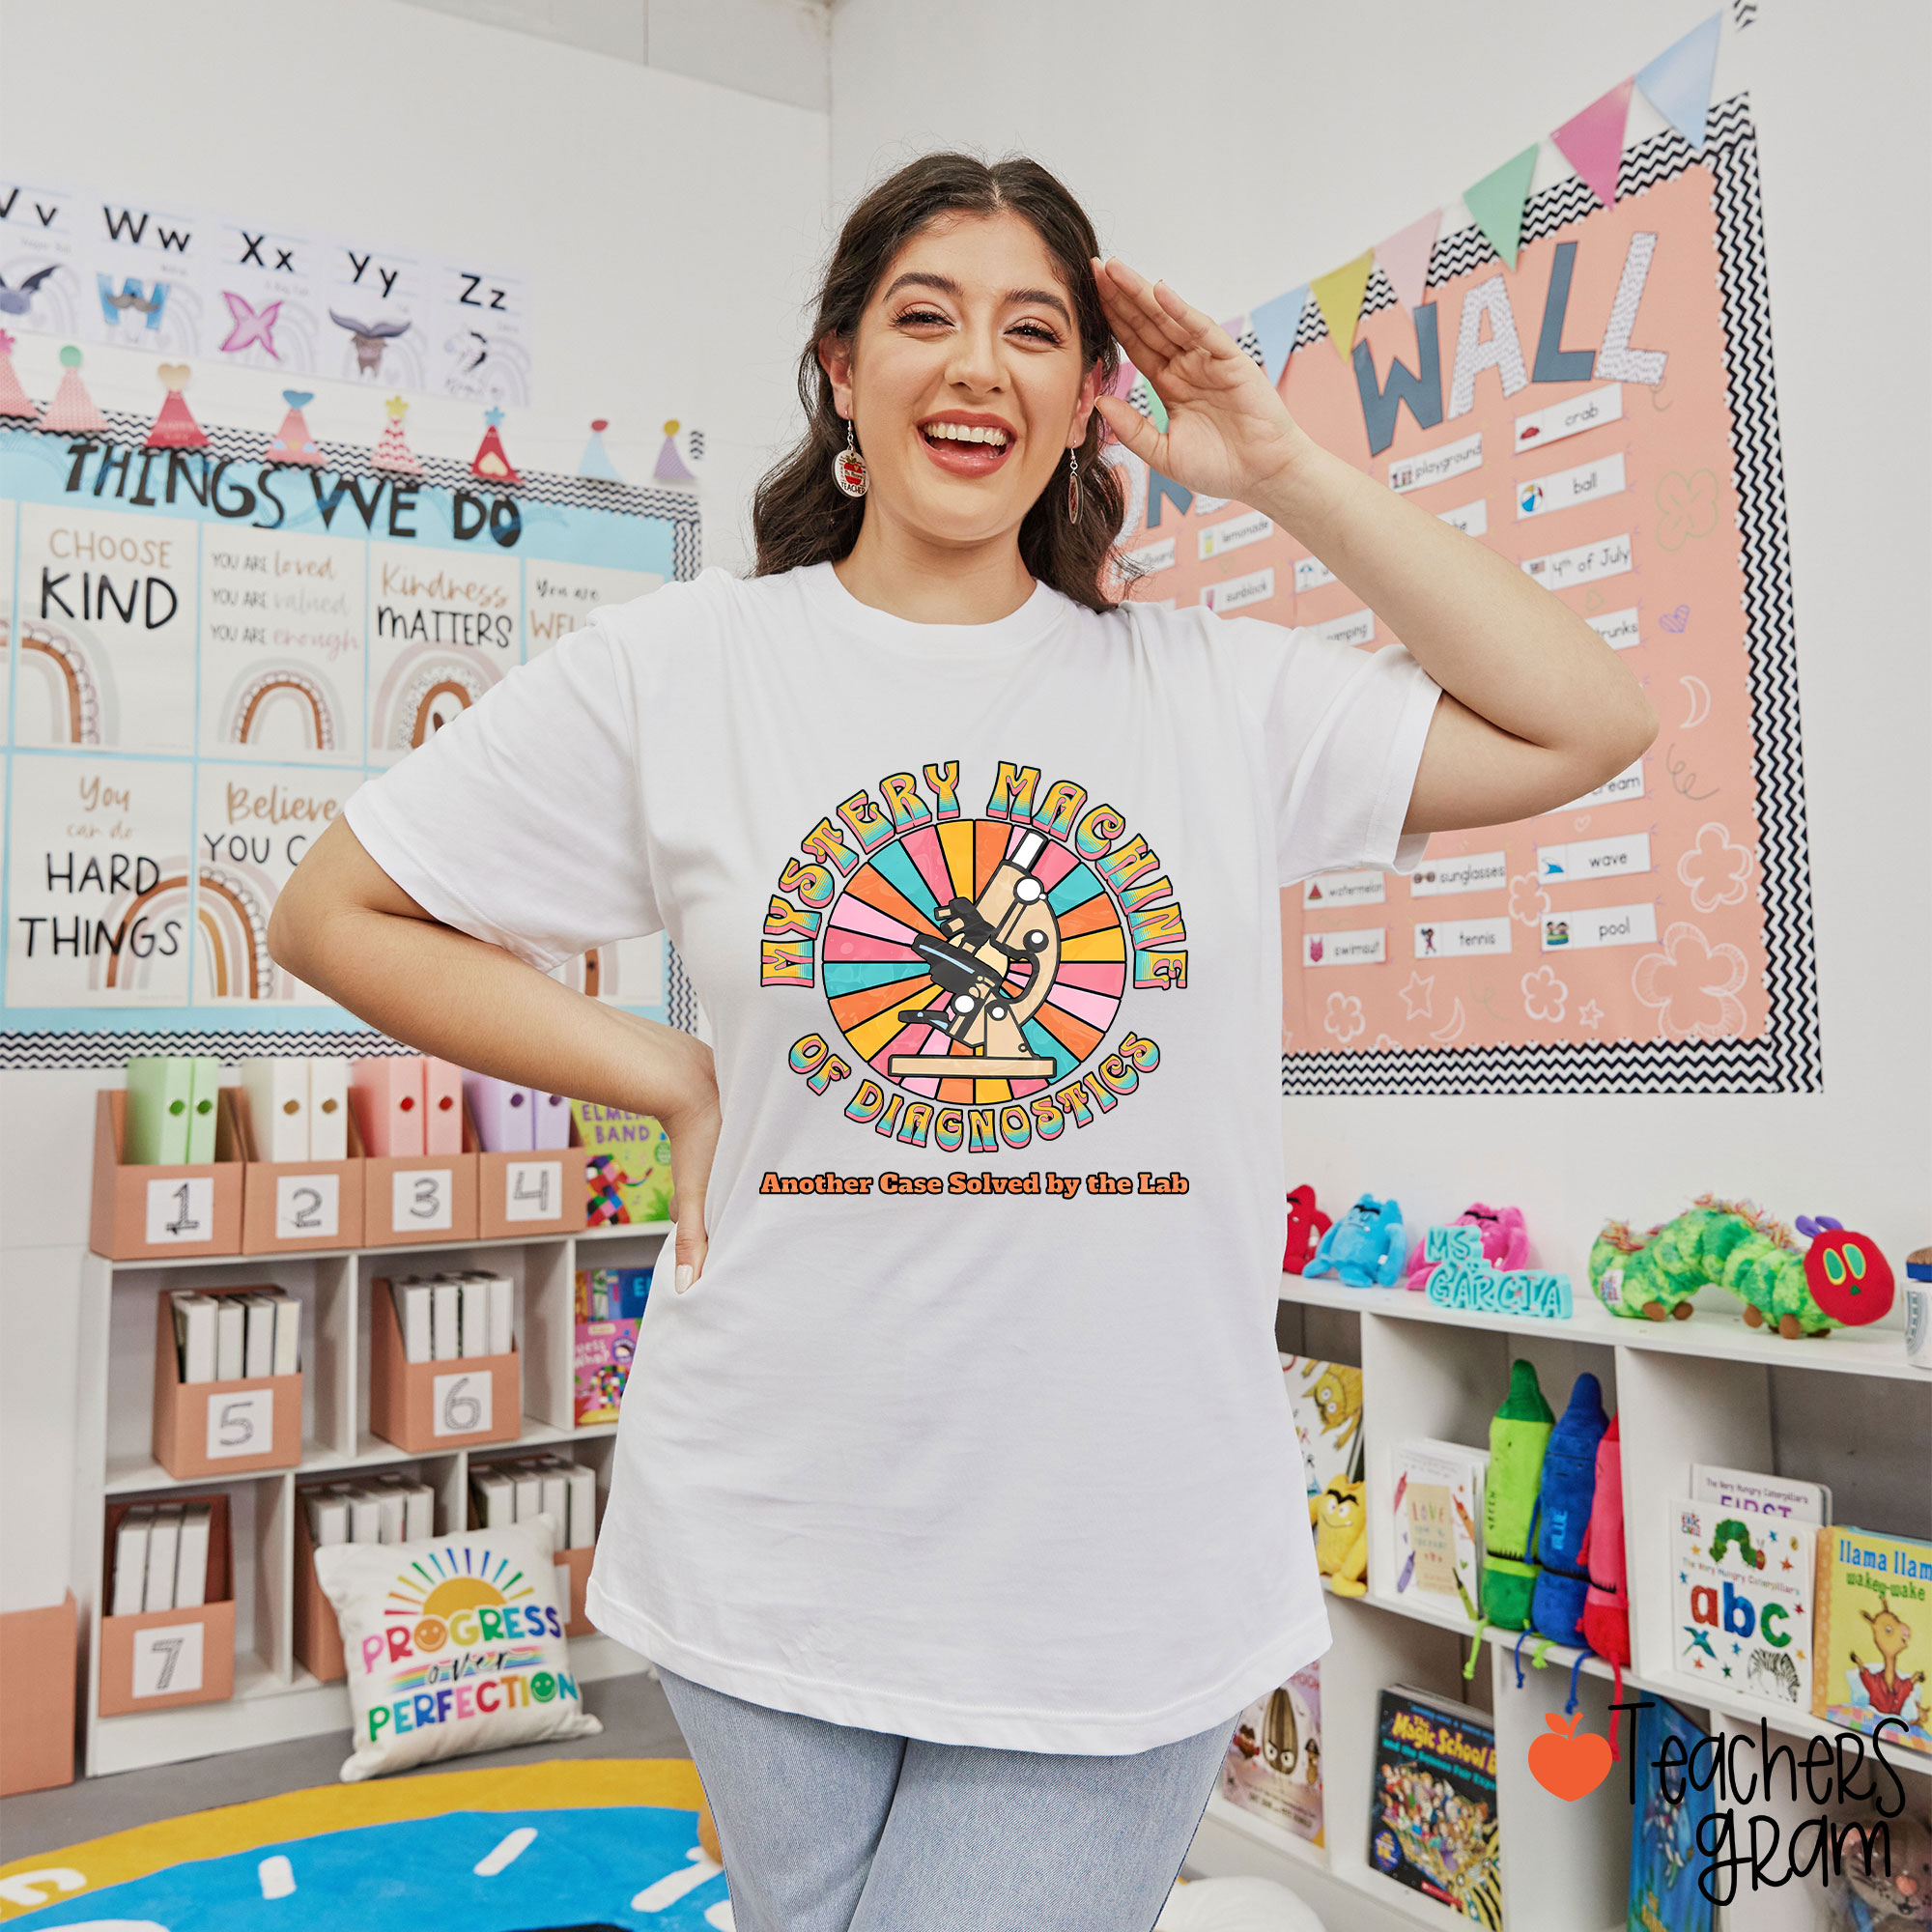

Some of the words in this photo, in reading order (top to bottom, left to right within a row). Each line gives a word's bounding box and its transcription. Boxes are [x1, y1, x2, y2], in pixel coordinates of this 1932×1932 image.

[1352, 232, 1668, 457] WALL
[1565, 402, 1599, 426] crab
[1415, 439, 1482, 479] playground
[66, 444, 284, 528] THINGS
[309, 474, 417, 538] WE
[453, 492, 523, 548] DO
[1573, 472, 1597, 494] ball
[49, 529, 173, 570] CHOOSE
[1223, 520, 1268, 543] lemonade
[212, 553, 240, 571] YOU
[244, 555, 267, 573] ARE
[274, 549, 335, 581] loved
[1577, 553, 1594, 573] of
[1600, 545, 1630, 566] July
[41, 566, 178, 630] KIND
[211, 588, 240, 607] YOU
[243, 589, 267, 609] ARE
[382, 560, 508, 609] Kindness
[211, 625, 240, 642] YOU
[243, 627, 266, 644] ARE
[272, 628, 359, 663] enough
[378, 606, 513, 648] MATTERS
[80, 777, 130, 811] You
[227, 781, 338, 824] Believe
[204, 833, 270, 864] YOU
[1589, 852, 1628, 868] wave
[46, 852, 159, 896] HARD
[760, 759, 961, 988] MYSTERY
[986, 760, 1189, 990] MACHINE
[1328, 880, 1384, 897] watermelon
[1439, 864, 1506, 886] sunglasses
[18, 916, 183, 958] THINGS
[1460, 930, 1496, 946] tennis
[1600, 916, 1631, 942] pool
[788, 1033, 851, 1095] OF
[844, 1031, 1160, 1153] DIAGNOSTICS
[595, 1124, 651, 1144] BAND
[409, 1178, 440, 1218] 3
[512, 1170, 549, 1212] 4
[759, 1172, 873, 1195] Another
[878, 1172, 943, 1195] Case
[948, 1172, 1041, 1195] Solved
[1045, 1172, 1080, 1199] by
[1085, 1172, 1134, 1195] the
[1137, 1172, 1189, 1195] Lab
[165, 1182, 199, 1236] 1
[290, 1187, 324, 1229] 2
[1429, 1262, 1563, 1317] GARCIA
[218, 1400, 255, 1445] 5
[443, 1377, 481, 1432] 6
[1839, 1539, 1888, 1572] llama
[1690, 1580, 1792, 1648] abc
[361, 1605, 562, 1675] PROGRESS
[151, 1636, 185, 1690] 7
[427, 1650, 510, 1684] over
[368, 1671, 579, 1743] PERFECTION
[1392, 1711, 1436, 1749] Magic
[1436, 1727, 1489, 1771] School
